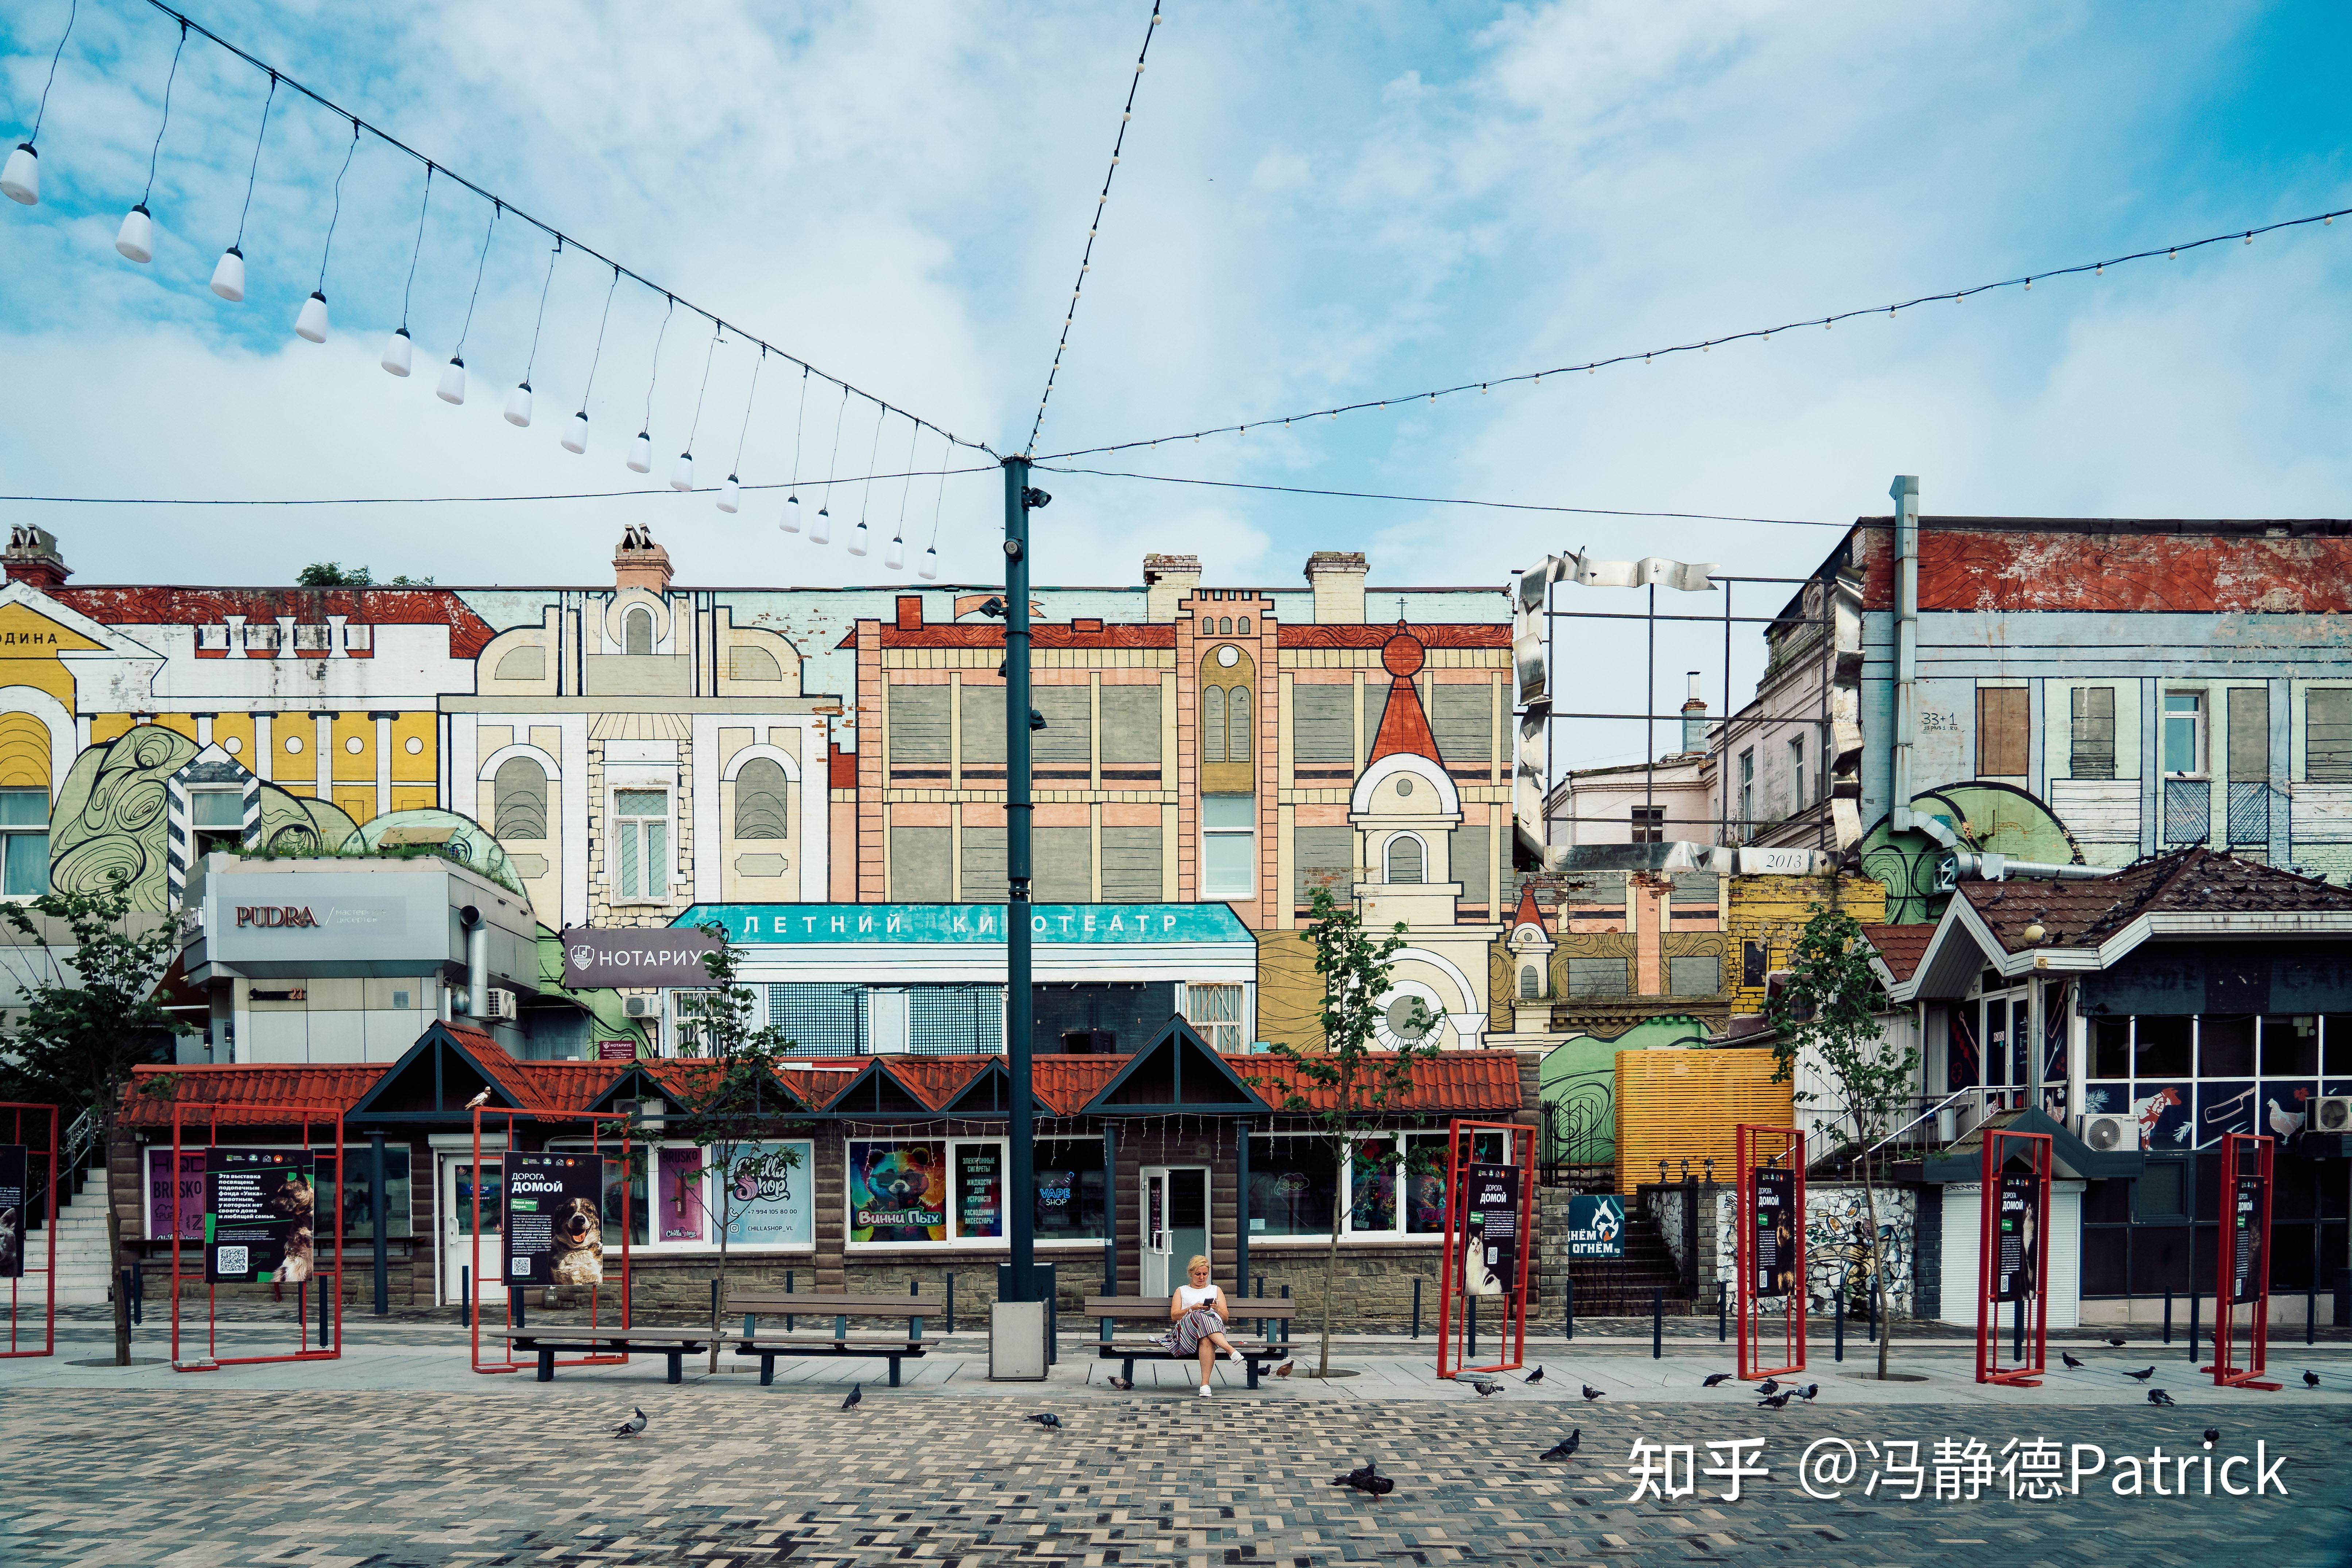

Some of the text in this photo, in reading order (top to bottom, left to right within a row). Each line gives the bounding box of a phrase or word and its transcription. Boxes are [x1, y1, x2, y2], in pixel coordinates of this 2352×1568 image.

[0, 633, 57, 645] ДИНА
[1766, 855, 1801, 868] 2013
[235, 906, 318, 926] PUDRA
[743, 913, 1176, 933] ЛЕТНИЙ КИОТЕАТР
[291, 988, 303, 999] 23
[512, 1173, 545, 1181] ДОРОГА
[512, 1181, 562, 1193] ДОМОЙ
[734, 1173, 787, 1200] Shop
[1040, 1188, 1070, 1198] VAPE
[1480, 1192, 1506, 1204] ДОМОЙ
[1759, 1195, 1779, 1207] ДОМОЙ
[2003, 1200, 2023, 1211] ДОМОЙ
[2238, 1200, 2253, 1212] ДОМОЙ
[859, 1211, 939, 1224] Винни Пых
[1354, 1220, 1369, 1229] PRIGOVOR
[1568, 1229, 1596, 1242] НЁМ
[1573, 1242, 1613, 1253] ОГНЁМ
